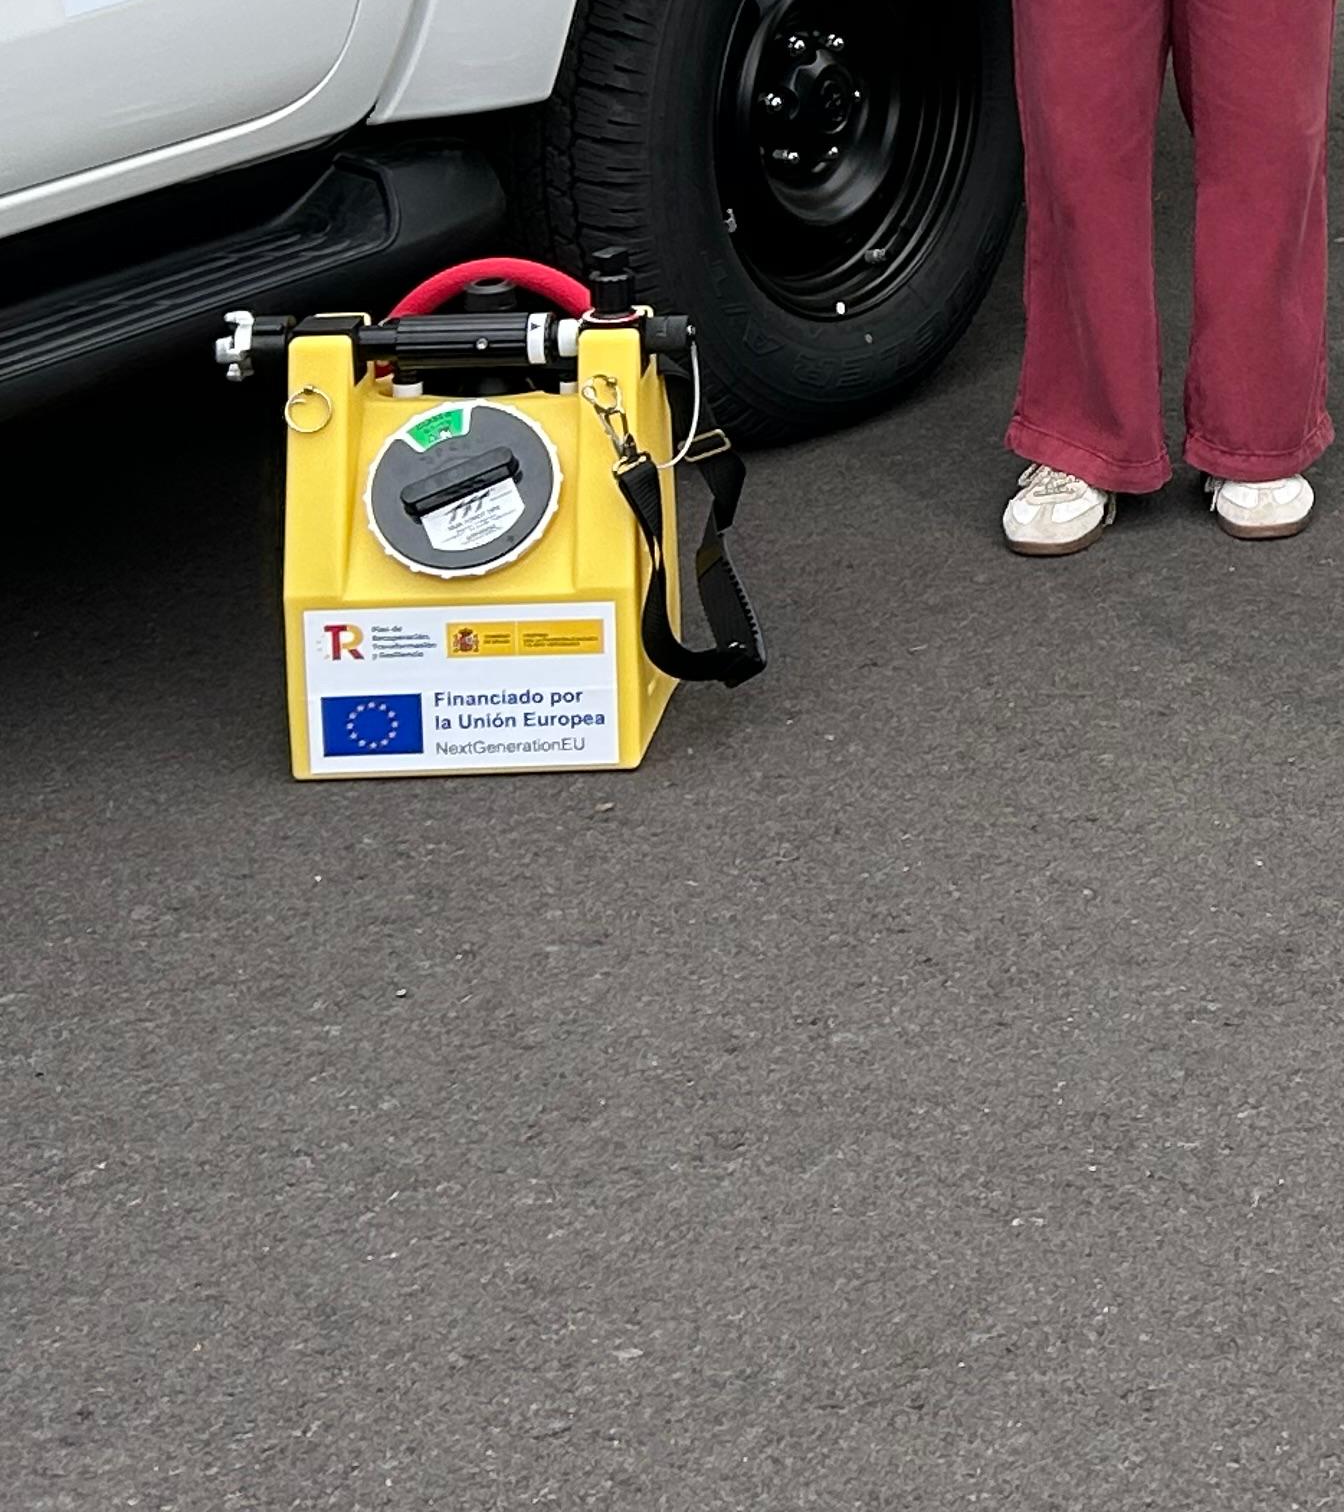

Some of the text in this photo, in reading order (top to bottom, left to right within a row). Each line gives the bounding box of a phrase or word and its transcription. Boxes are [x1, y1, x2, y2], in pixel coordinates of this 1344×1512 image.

[434, 690, 583, 708] Financiado por
[435, 710, 606, 731] la Unión Europea
[436, 737, 585, 755] NextGenerationEU
